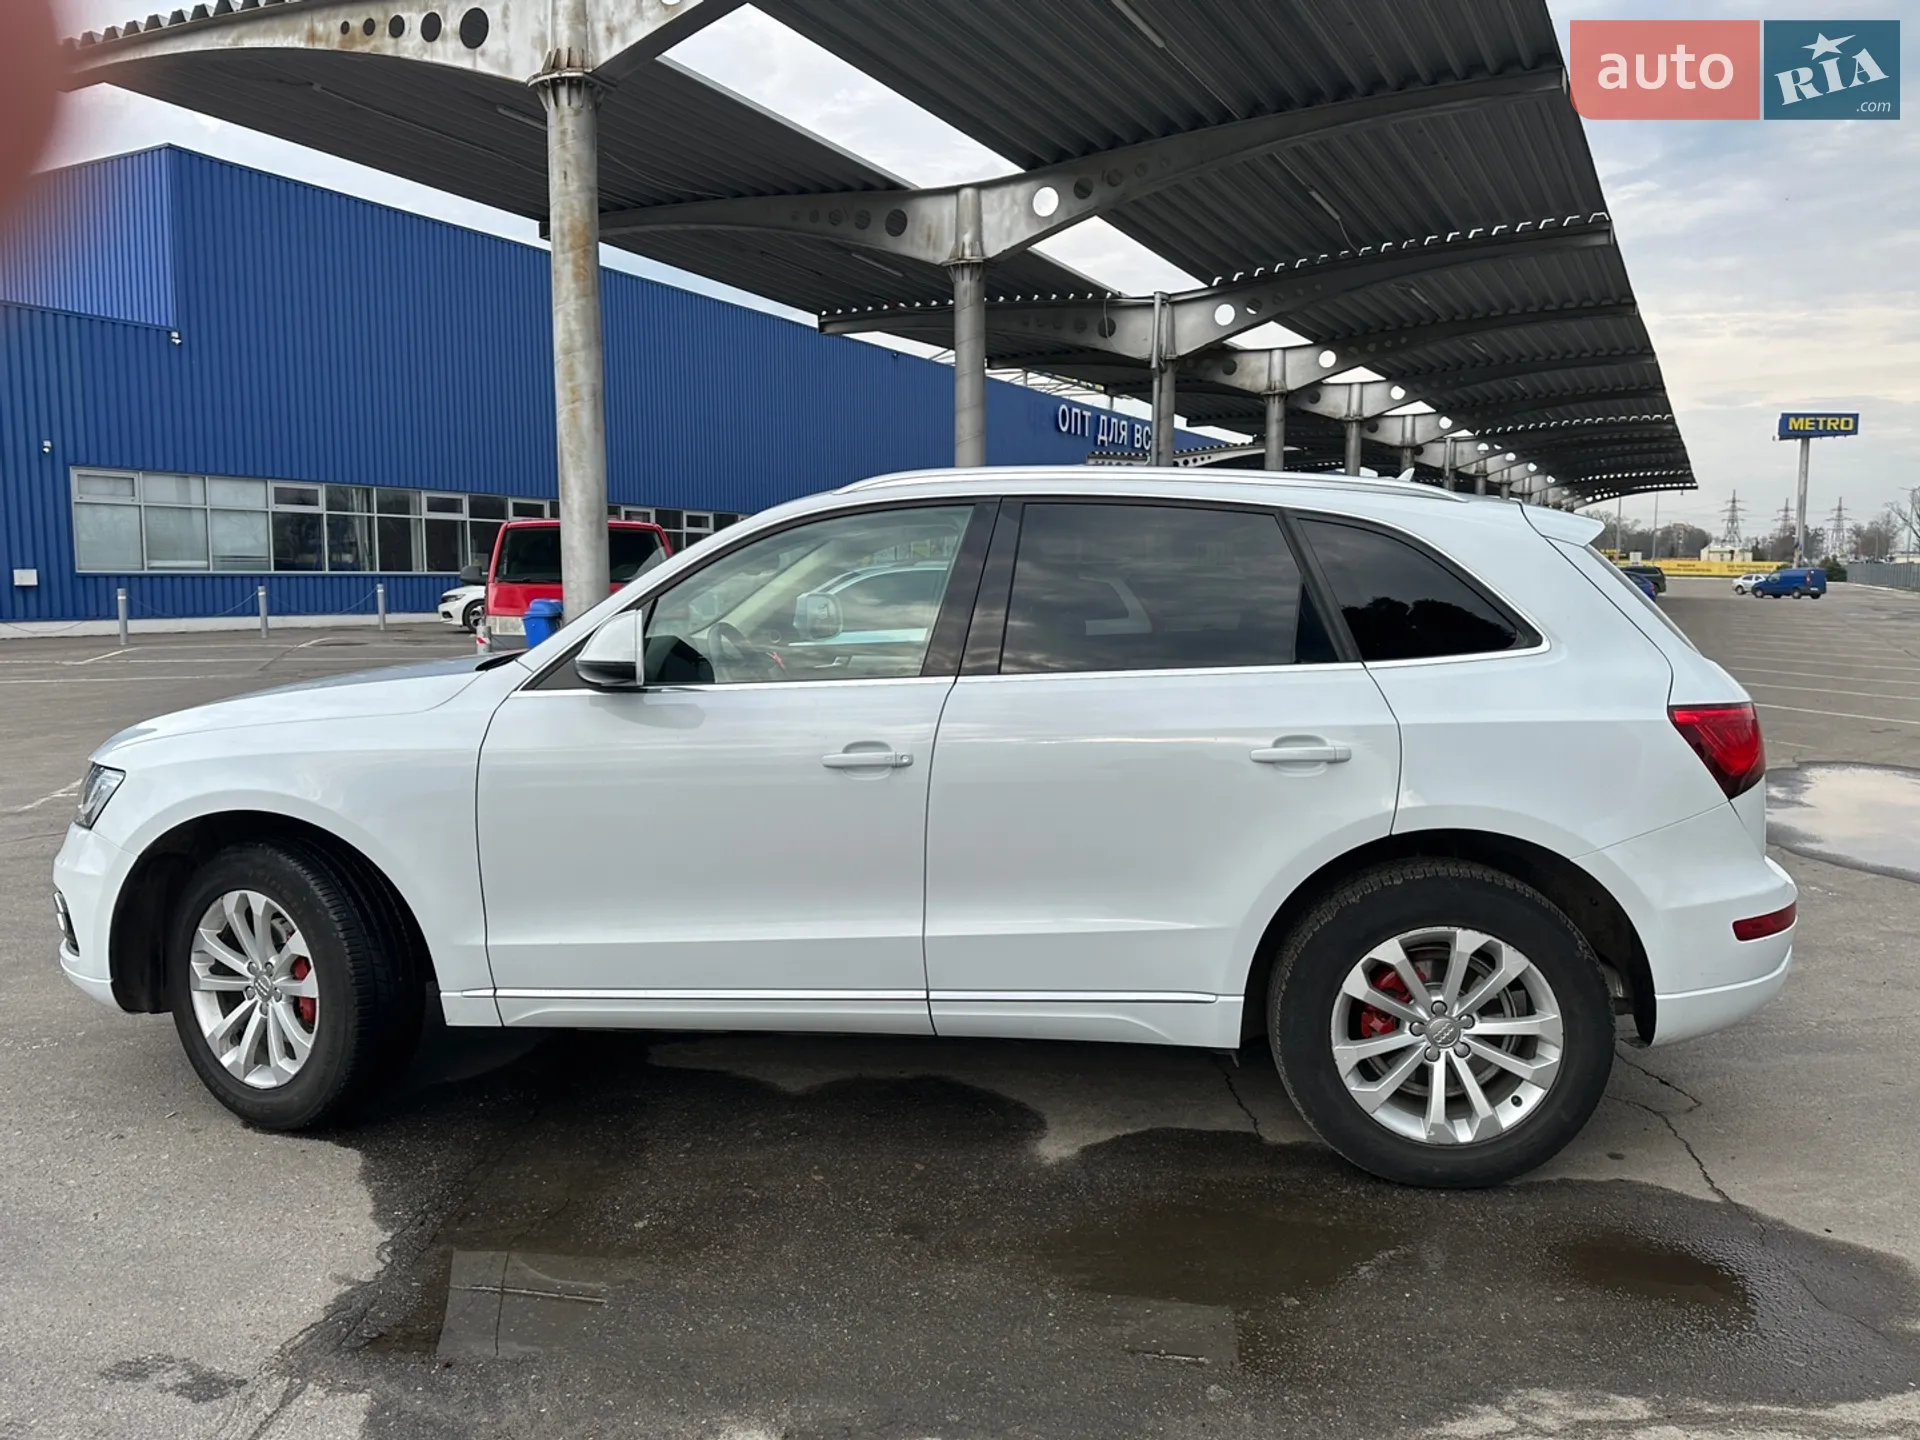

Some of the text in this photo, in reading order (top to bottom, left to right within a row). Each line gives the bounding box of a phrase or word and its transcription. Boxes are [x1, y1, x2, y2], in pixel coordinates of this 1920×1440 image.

[1058, 404, 1152, 450] ОПТ ДЛЯ ВС
[1788, 417, 1854, 431] METRO
